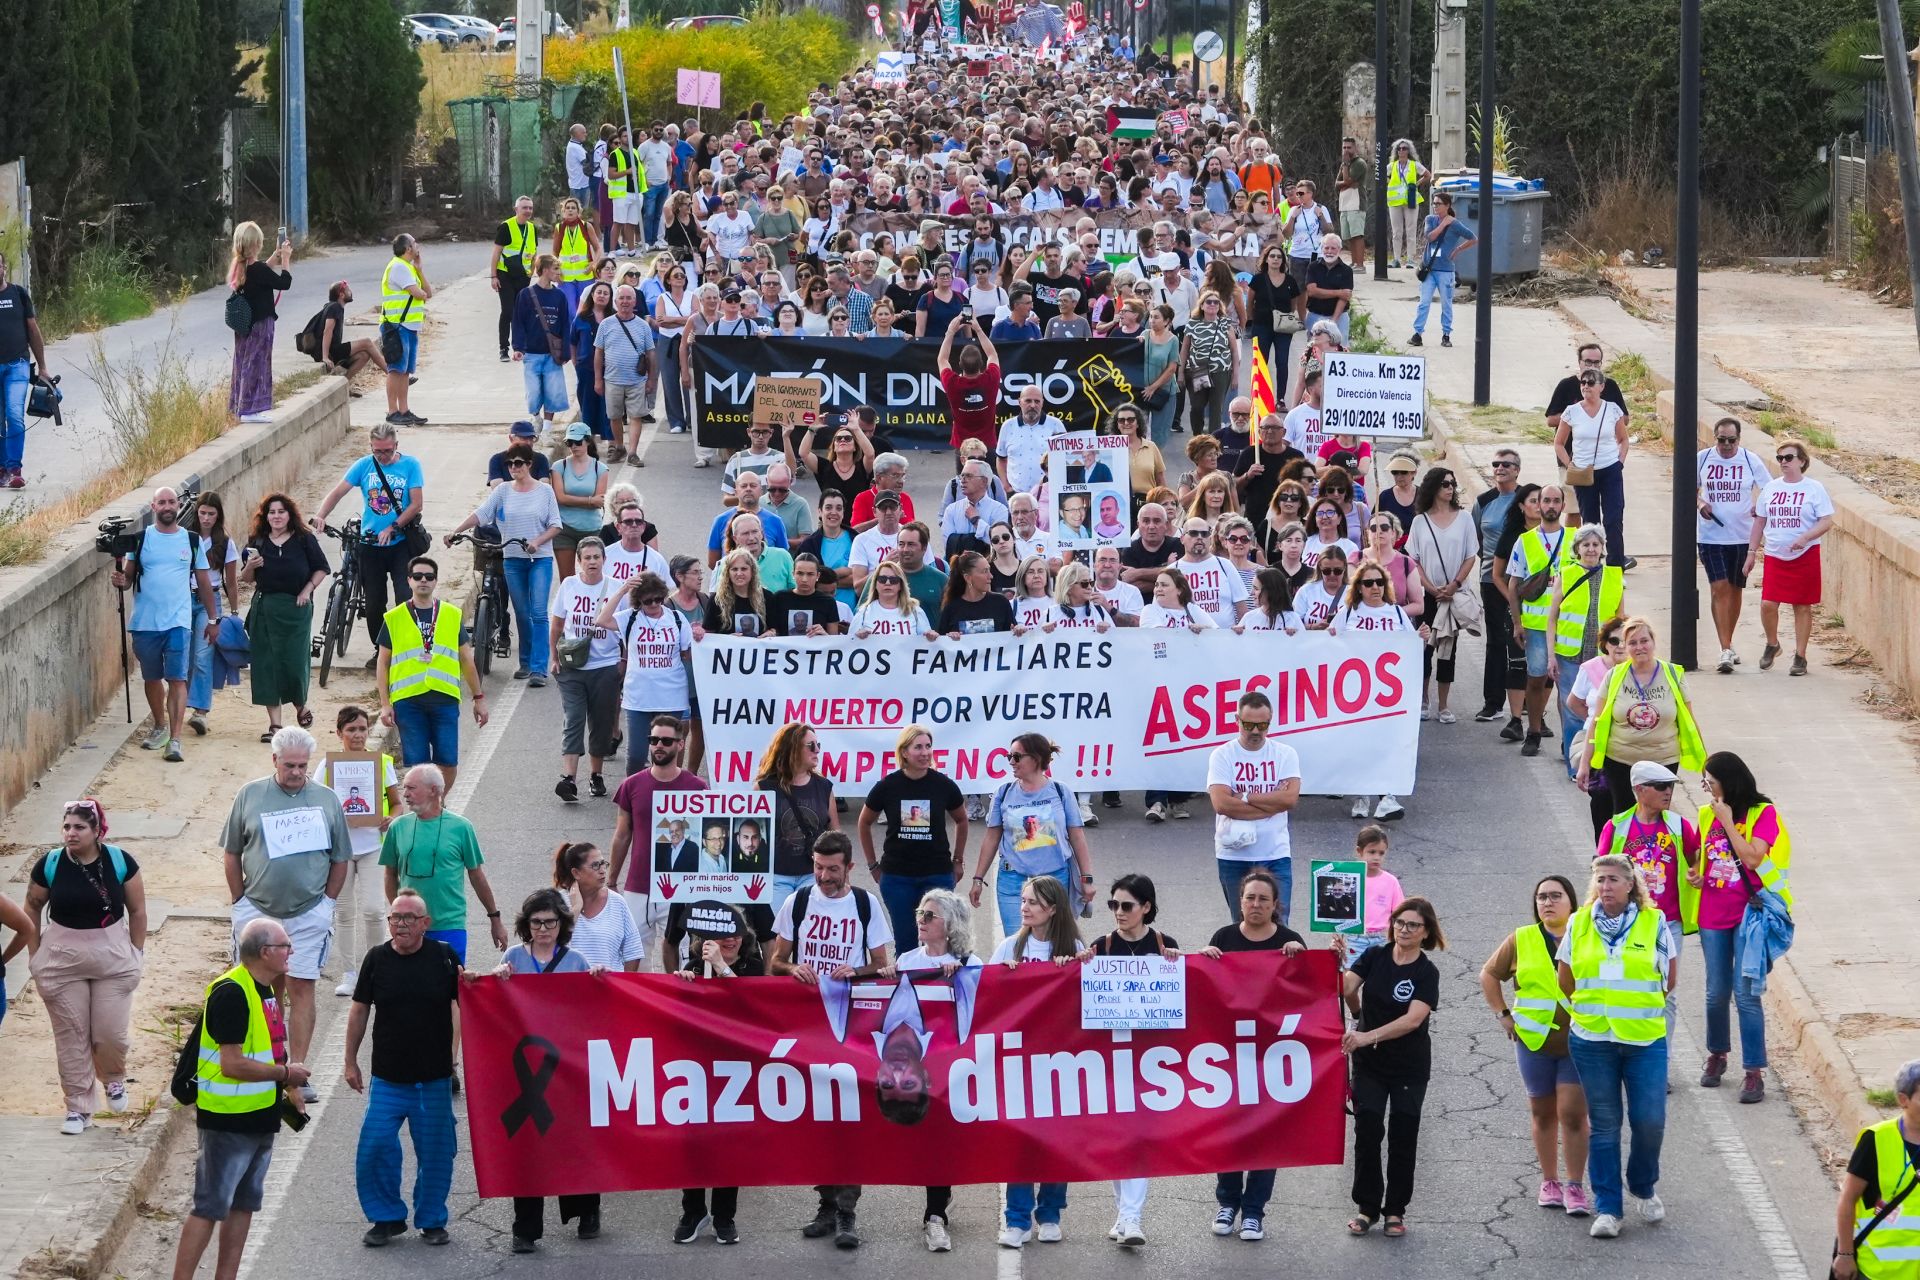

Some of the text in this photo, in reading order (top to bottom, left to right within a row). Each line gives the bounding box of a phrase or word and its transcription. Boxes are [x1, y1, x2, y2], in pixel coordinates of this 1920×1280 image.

[1352, 368, 1376, 378] Chiva.
[1379, 363, 1396, 379] Km
[1399, 364, 1421, 380] 322
[1337, 387, 1412, 400] Dirección Valencia
[760, 396, 816, 410] DEL CONSELL
[886, 412, 899, 424] la
[906, 412, 947, 424] DANA
[1325, 409, 1386, 429] 29/10/2024
[1392, 412, 1421, 430] 19:50
[1706, 464, 1744, 480] 20:11
[1706, 480, 1743, 491] NI OBLIT
[1708, 491, 1741, 503] NI PERDÓ
[1770, 491, 1805, 506] 20:11
[1768, 506, 1802, 517] NI OBLIT
[1770, 517, 1801, 529] NI PERDÓ
[1193, 589, 1220, 602] OBLIT
[872, 620, 911, 635] 20:11
[1356, 615, 1394, 631] 20:11
[637, 626, 676, 643] 20:11
[637, 643, 676, 655] NI OBLIT
[711, 641, 1113, 676] NUESTROS FAMILIARES
[711, 691, 1113, 726] HAN MUERTO POR VUESTRA
[1235, 760, 1276, 782] 20:11
[656, 794, 771, 815] JUSTICIA
[683, 873, 739, 883] por mi marido
[689, 884, 733, 895] y mis hijos
[691, 907, 733, 921] MAZÓN
[686, 918, 737, 934] DIMISSIÓ
[806, 914, 857, 944] 20:11
[804, 941, 852, 962] NI OBLIT
[1093, 957, 1178, 975] JUSTICIA PARA
[1083, 979, 1180, 991] MIGUEL Y SARA CARPIO
[1083, 1008, 1183, 1018] Y TODAS LAS VICTIMAS
[588, 1014, 1314, 1127] Mazón dimissió
